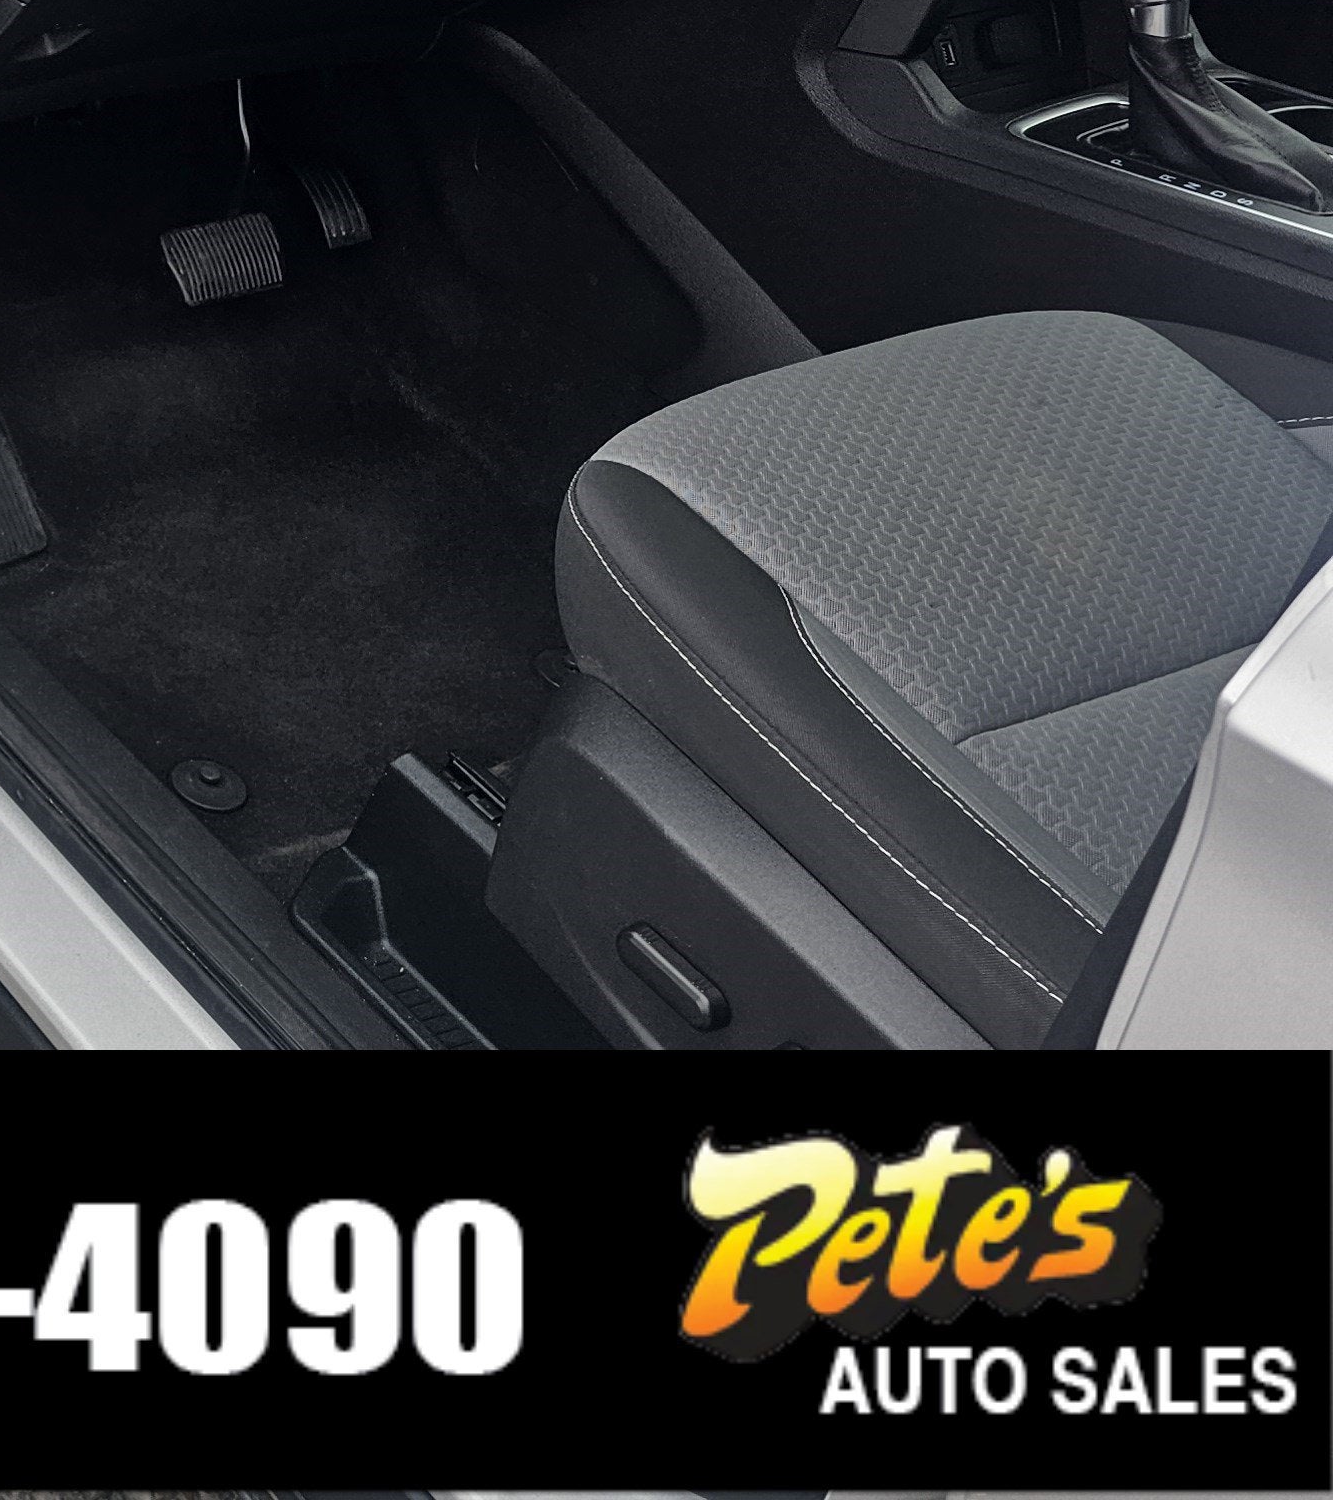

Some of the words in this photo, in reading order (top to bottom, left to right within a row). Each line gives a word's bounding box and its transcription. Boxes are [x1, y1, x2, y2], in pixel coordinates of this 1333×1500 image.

[1110, 158, 1123, 167] P
[1158, 173, 1177, 182] R
[1184, 181, 1202, 191] N
[1209, 190, 1228, 199] D
[1237, 197, 1254, 207] S
